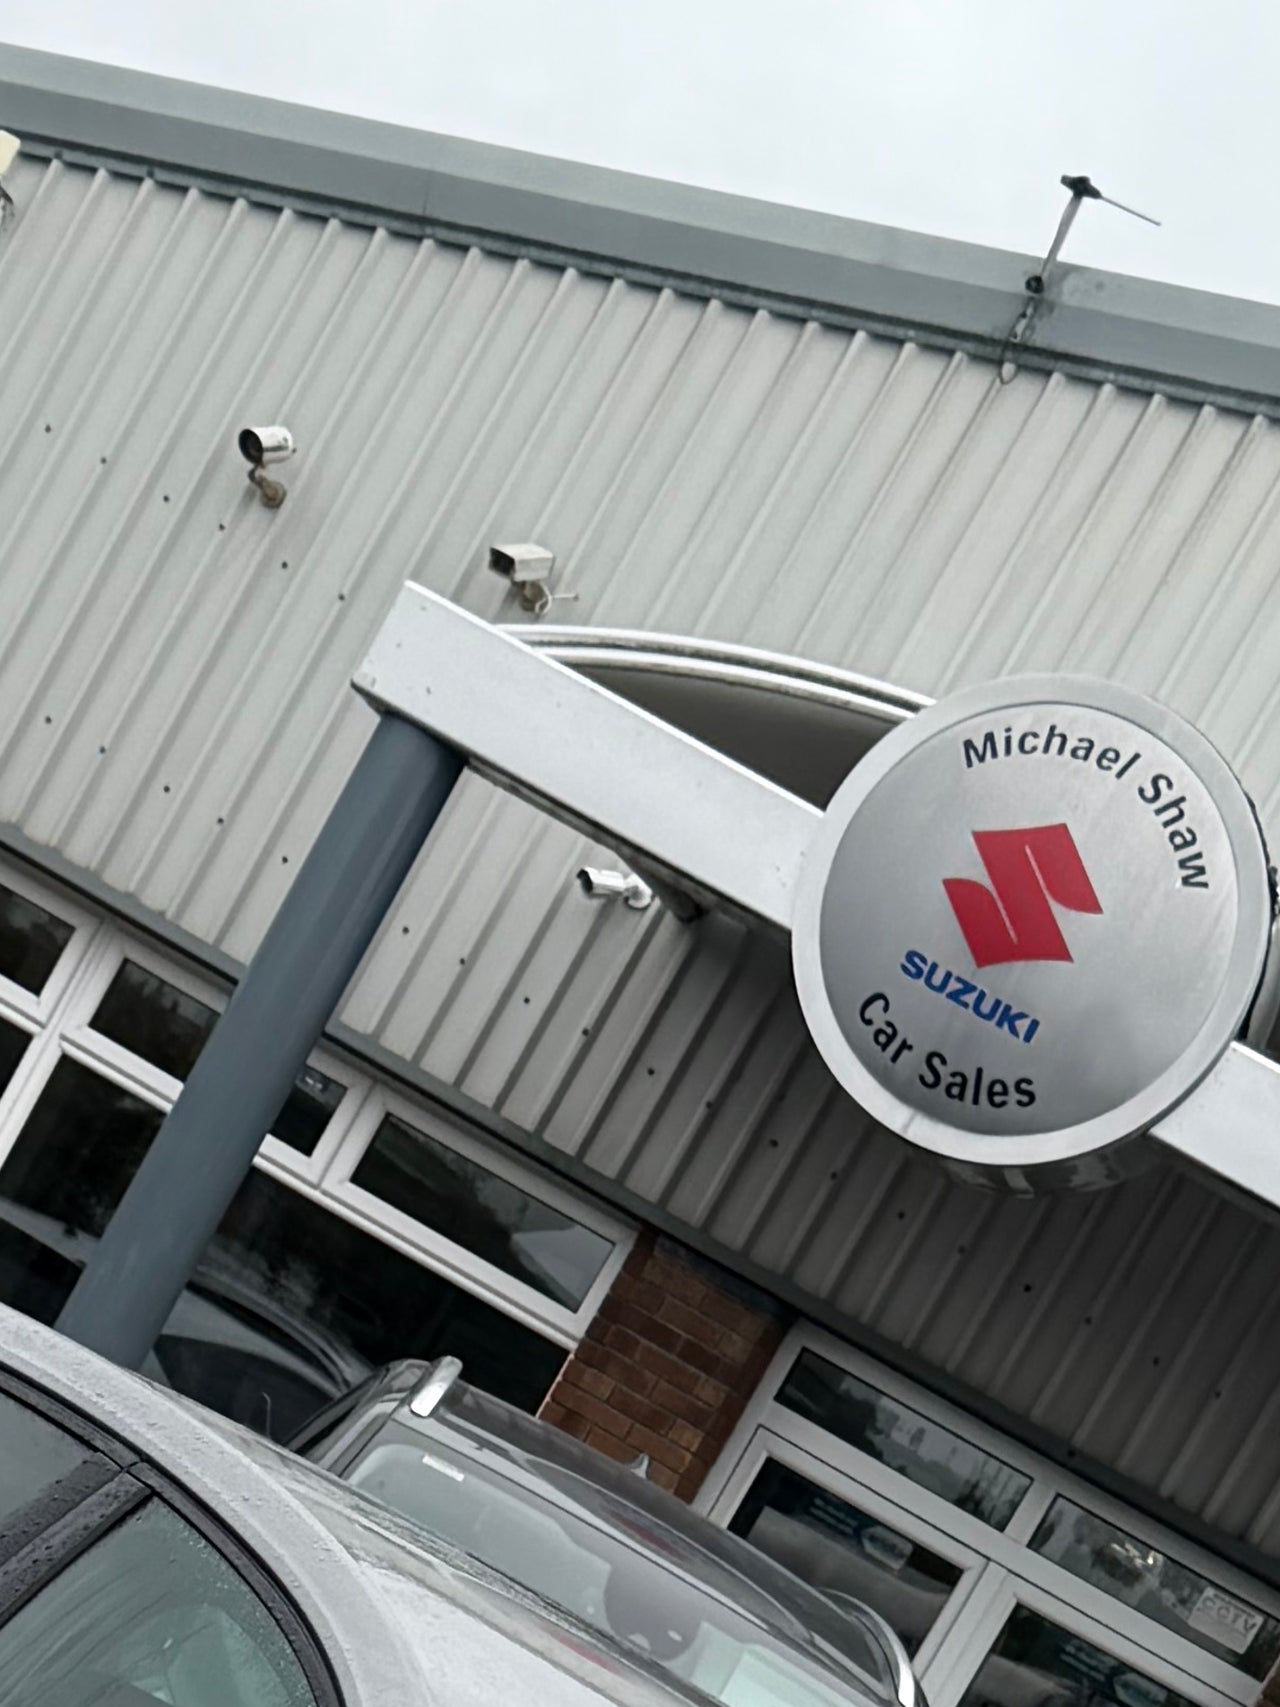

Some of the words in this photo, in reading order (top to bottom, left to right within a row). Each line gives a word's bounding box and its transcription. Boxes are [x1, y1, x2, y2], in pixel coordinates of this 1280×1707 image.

[962, 724, 1142, 780] Michael
[1137, 772, 1210, 890] Shaw
[858, 991, 914, 1066] Car
[918, 1050, 1037, 1108] Sales
[900, 949, 1041, 1044] SUZUKI
